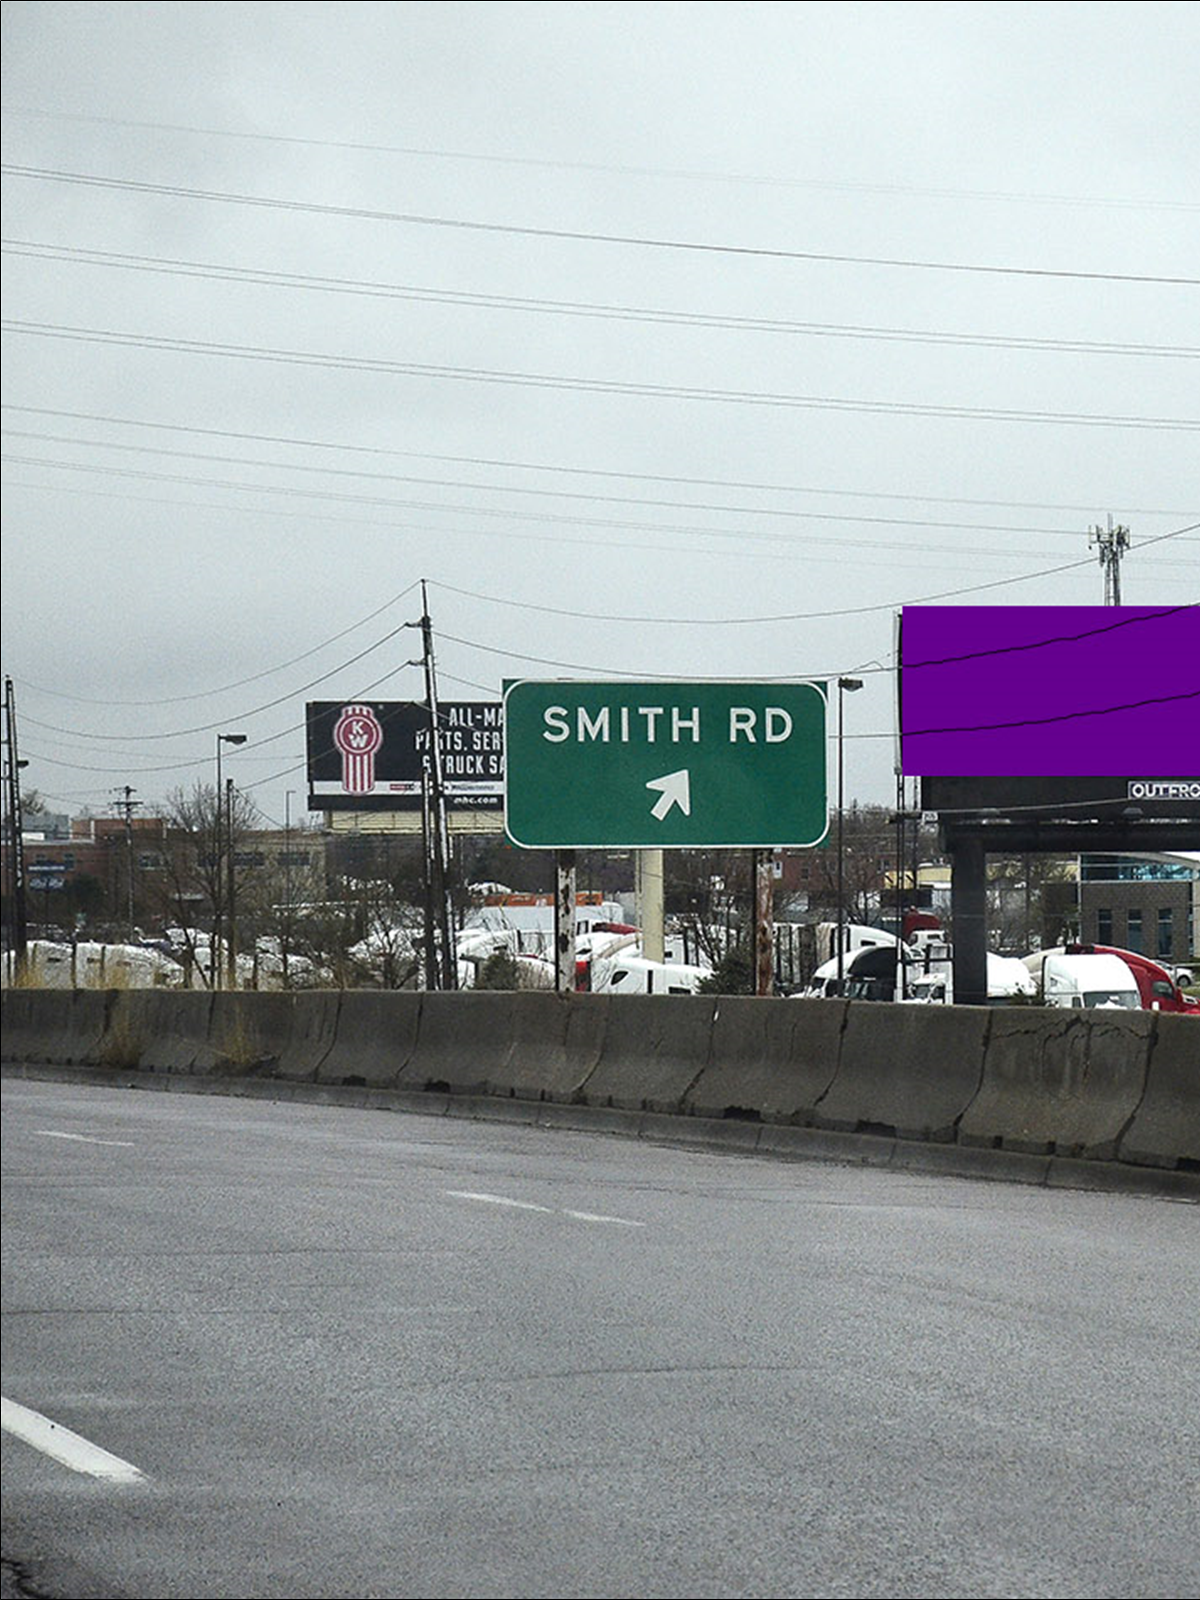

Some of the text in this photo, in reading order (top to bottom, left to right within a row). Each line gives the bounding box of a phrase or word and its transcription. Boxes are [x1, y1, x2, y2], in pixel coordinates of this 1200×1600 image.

[449, 707, 504, 727] ALL-MA
[542, 706, 793, 742] SMITH RD
[473, 731, 504, 750] SER
